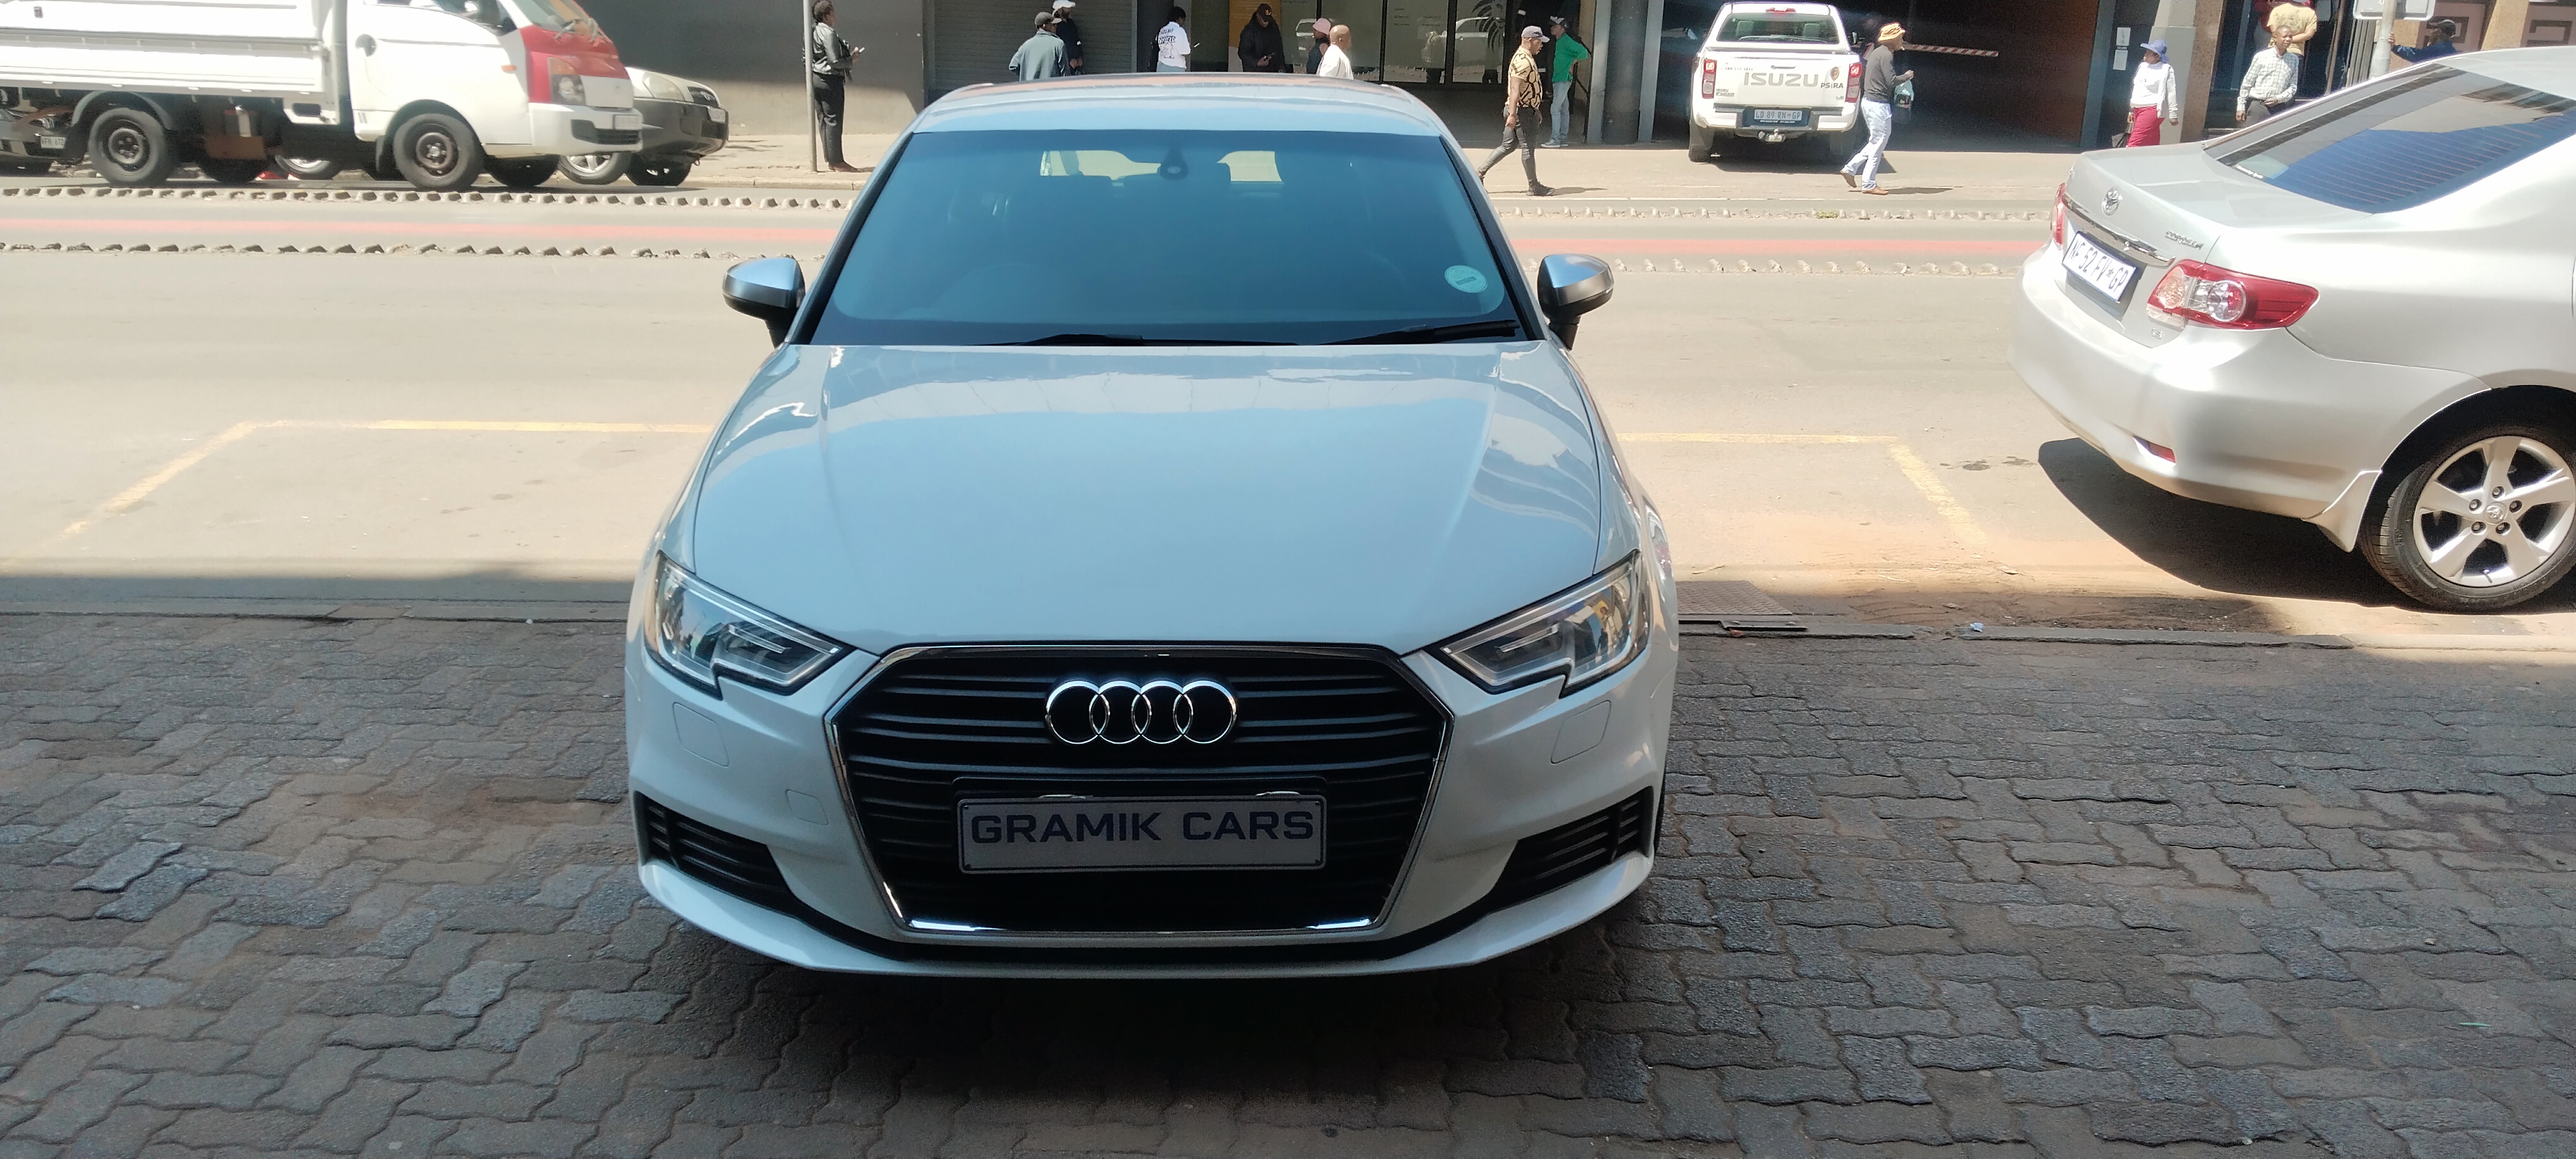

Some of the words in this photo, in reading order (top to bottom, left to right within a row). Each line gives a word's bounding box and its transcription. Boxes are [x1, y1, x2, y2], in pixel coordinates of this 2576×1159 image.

[1743, 72, 1818, 87] ISUZU
[2067, 239, 2085, 263] NF
[2078, 247, 2098, 273] 52
[2090, 256, 2113, 282] FV
[2108, 267, 2129, 293] GP
[971, 812, 1162, 843] GRAMIK
[1183, 811, 1313, 840] CARS
